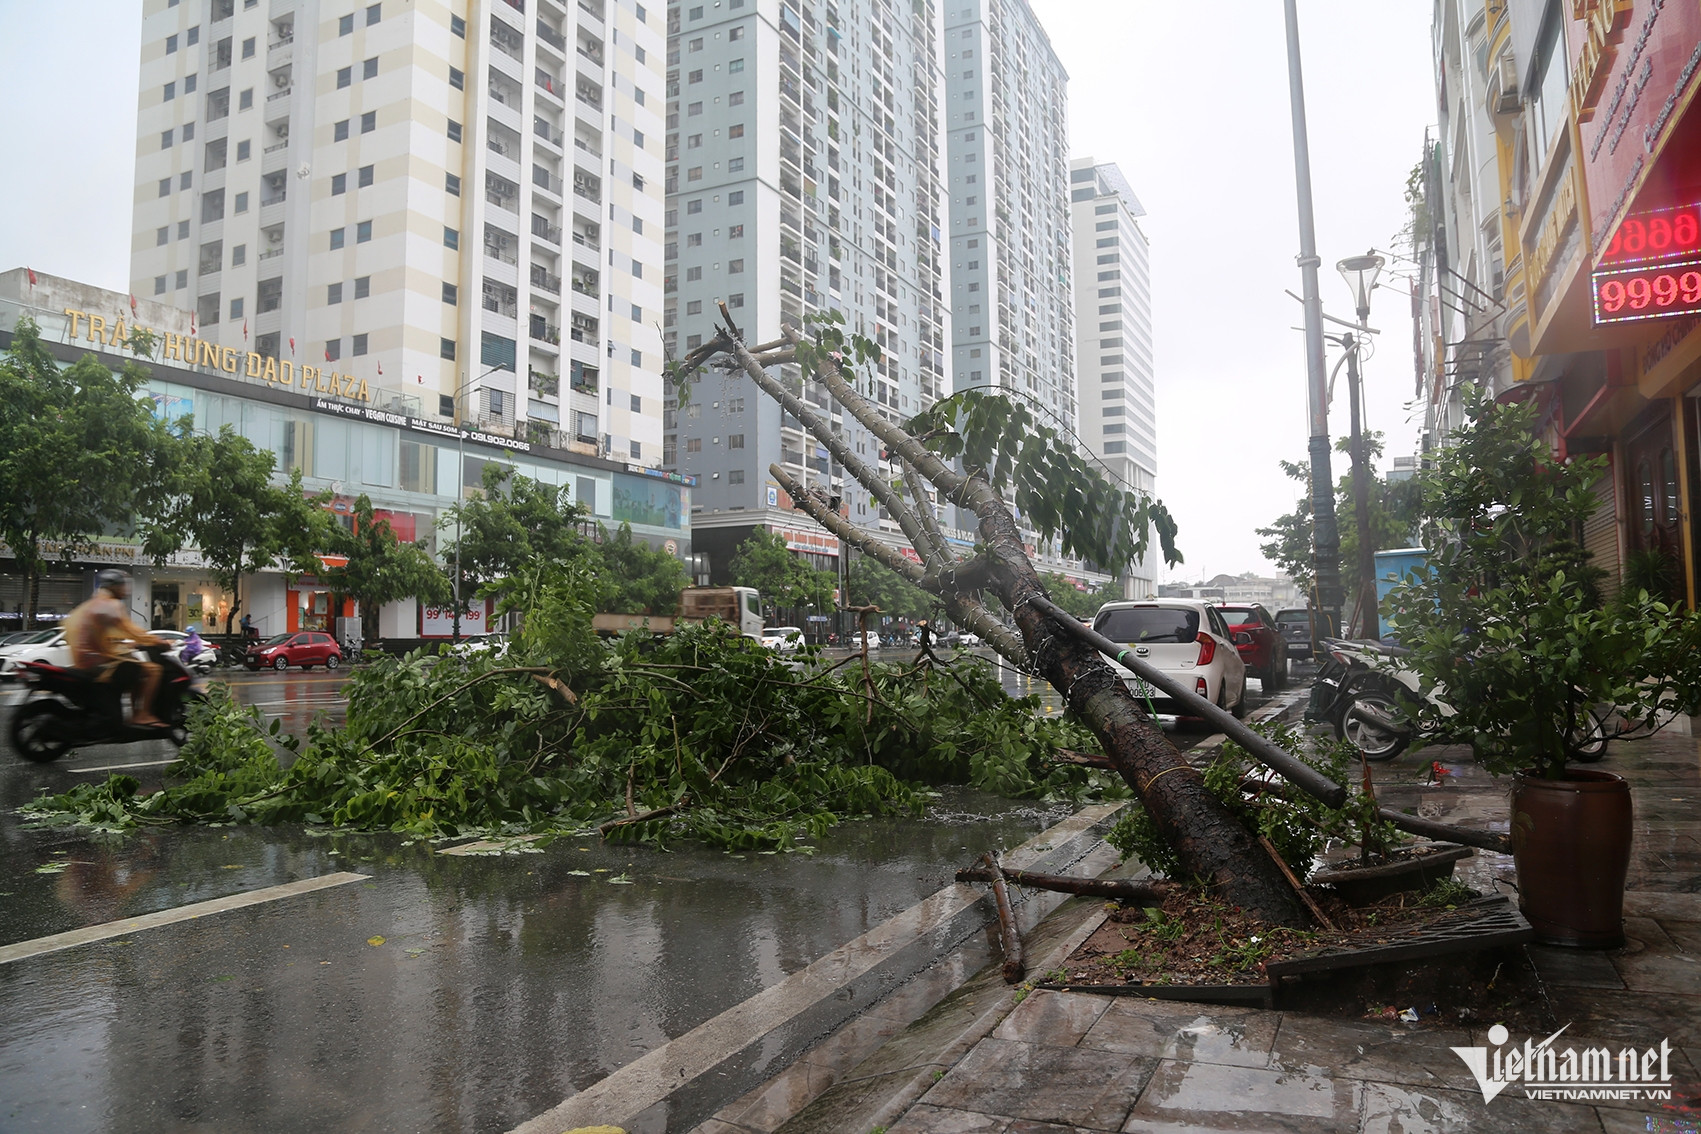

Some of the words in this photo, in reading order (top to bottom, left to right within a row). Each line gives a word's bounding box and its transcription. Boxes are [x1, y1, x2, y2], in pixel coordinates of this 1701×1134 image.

[1601, 272, 1701, 312] 9999
[246, 352, 293, 388] ĐẠO
[301, 365, 371, 402] PLAZA
[345, 406, 361, 415] CHAY
[365, 408, 386, 422] VEGAN
[386, 413, 407, 426] CUISINE
[428, 422, 442, 430] SAU
[471, 431, 530, 451] 091.902.0066
